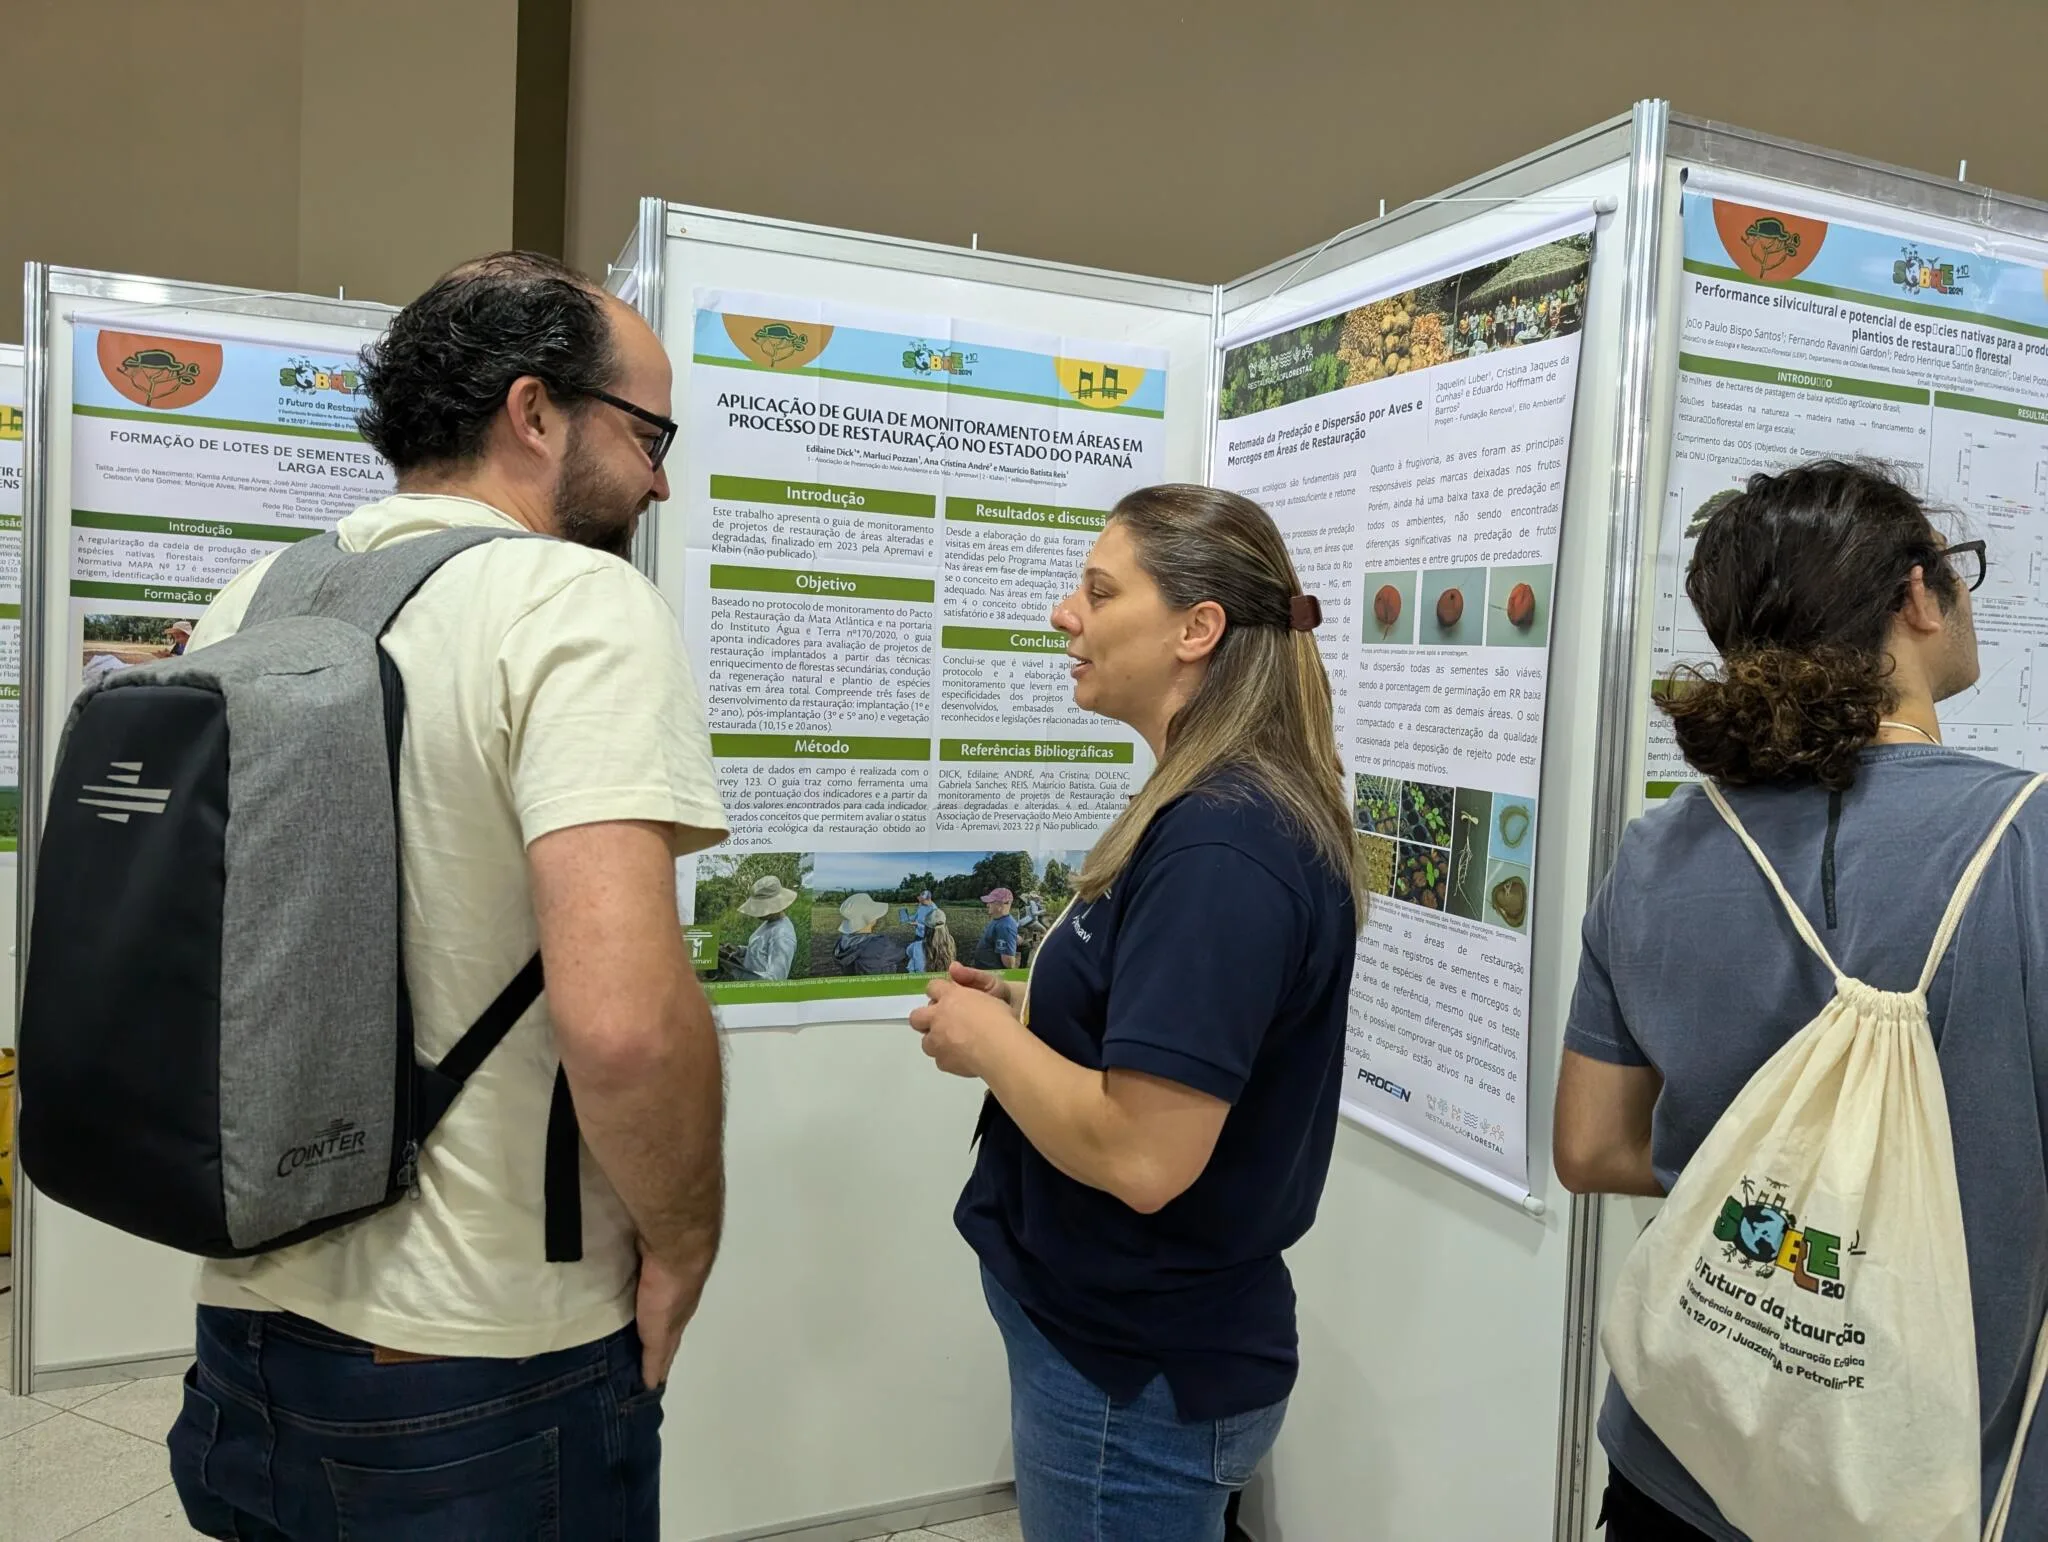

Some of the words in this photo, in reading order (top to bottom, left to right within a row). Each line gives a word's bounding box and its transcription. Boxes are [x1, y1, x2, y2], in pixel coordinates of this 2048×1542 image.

[1695, 280, 1770, 306] Performance
[1772, 294, 1838, 317] silvicultural
[1840, 309, 1846, 319] e
[1848, 310, 1896, 328] potencial
[1899, 317, 1912, 331] de
[1960, 330, 1995, 345] nativas
[1996, 337, 2016, 349] para
[2017, 341, 2023, 351] a
[1850, 327, 1894, 346] plantios
[1896, 334, 1909, 348] de
[1975, 347, 2011, 365] florestal
[1496, 365, 1527, 378] Cristina
[1529, 358, 1558, 372] Jaques
[1560, 355, 1570, 365] da
[1465, 389, 1470, 397] e
[1472, 381, 1504, 396] Eduardo
[1545, 372, 1556, 382] de
[278, 397, 284, 405] O
[285, 397, 313, 408] Futuro
[315, 401, 325, 410] da
[327, 402, 366, 413] Restaur
[716, 392, 816, 418] APLICAÇÃO
[819, 403, 839, 419] DE
[842, 406, 884, 424] GUIA
[887, 411, 907, 427] DE
[910, 414, 1050, 442] MONITORAMENTO
[1053, 430, 1073, 445] EM
[1076, 430, 1120, 450] ÁREAS
[1122, 438, 1142, 456] EM
[1228, 435, 1265, 452] Retomada
[1266, 432, 1275, 443] da
[1277, 423, 1312, 445] Predação
[1314, 423, 1320, 432] e
[1322, 412, 1366, 430] Dispersão
[1368, 408, 1386, 423] por
[1387, 402, 1413, 416] Aves
[1416, 400, 1423, 410] e
[110, 430, 194, 448] FORMAÇÃO
[199, 438, 218, 450] DE
[223, 441, 269, 455] LOTES
[273, 445, 292, 457] DE
[296, 448, 370, 464] SEMENTES
[729, 412, 816, 435] PROCESSO
[819, 421, 839, 437] DE
[842, 424, 959, 452] RESTAURAÇÃO
[962, 437, 986, 453] NO
[989, 440, 1047, 459] ESTADO
[1050, 447, 1072, 462] DO
[1075, 450, 1132, 469] PARANÁ
[1227, 452, 1262, 466] Morcegos
[1263, 449, 1275, 459] em
[1276, 442, 1298, 456] Áreas
[1299, 439, 1310, 451] de
[1312, 427, 1366, 448] Restauração
[278, 461, 326, 475] LARGA
[330, 465, 384, 480] ESCALA
[806, 444, 835, 455] Edilaine
[862, 450, 891, 461] Marluci
[923, 457, 939, 466] Ana
[939, 458, 966, 469] Cristina
[998, 464, 1029, 475] Maurício
[1029, 467, 1052, 477] Batista
[787, 485, 865, 508] Introdução
[712, 506, 732, 517] Este
[734, 508, 774, 520] trabalho
[776, 513, 820, 524] apresenta
[823, 517, 830, 525] o
[831, 516, 850, 528] guia
[853, 517, 865, 528] de
[867, 521, 934, 534] monitoramento
[976, 503, 1045, 522] Resultados
[1047, 513, 1055, 522] e
[1057, 510, 1106, 528] discussã
[169, 521, 232, 536] Introdução
[77, 534, 84, 543] A
[87, 536, 145, 548] regularização
[148, 540, 159, 548] da
[162, 542, 190, 550] cadeia
[193, 543, 204, 551] de
[207, 545, 247, 555] produção
[250, 547, 261, 555] de
[77, 546, 114, 556] espécies
[125, 550, 155, 559] nativas
[165, 551, 204, 562] florestais
[214, 556, 254, 565] conforme
[77, 556, 122, 567] Normativa
[128, 560, 153, 569] MAPA
[175, 563, 186, 571] 17
[191, 564, 197, 572] é
[202, 566, 239, 575] essencial
[1364, 559, 1382, 568] entre
[1383, 556, 1420, 566] ambientes
[1421, 556, 1427, 564] e
[1428, 554, 1449, 564] entre
[1450, 553, 1478, 565] grupos
[1480, 551, 1490, 561] de
[1492, 549, 1542, 562] predadores.
[76, 568, 109, 578] origem,
[111, 569, 165, 581] identificação
[174, 575, 215, 584] qualidade
[795, 574, 856, 593] Objetivo
[144, 588, 202, 602] Formação
[794, 739, 849, 753] Método
[961, 742, 1031, 756] Referências
[1034, 744, 1114, 760] Bibliográficas
[1357, 1067, 1411, 1103] PROGEN
[277, 1131, 366, 1178] COINTER
[1695, 1256, 1702, 1272] O
[1700, 1263, 1757, 1306] Futuro
[1760, 1297, 1785, 1319] da
[1688, 1282, 1733, 1317] Conferência
[1734, 1312, 1780, 1340] Brasileira
[1687, 1307, 1692, 1316] a
[1693, 1310, 1727, 1335] 12/07
[1786, 1364, 1794, 1374] e
